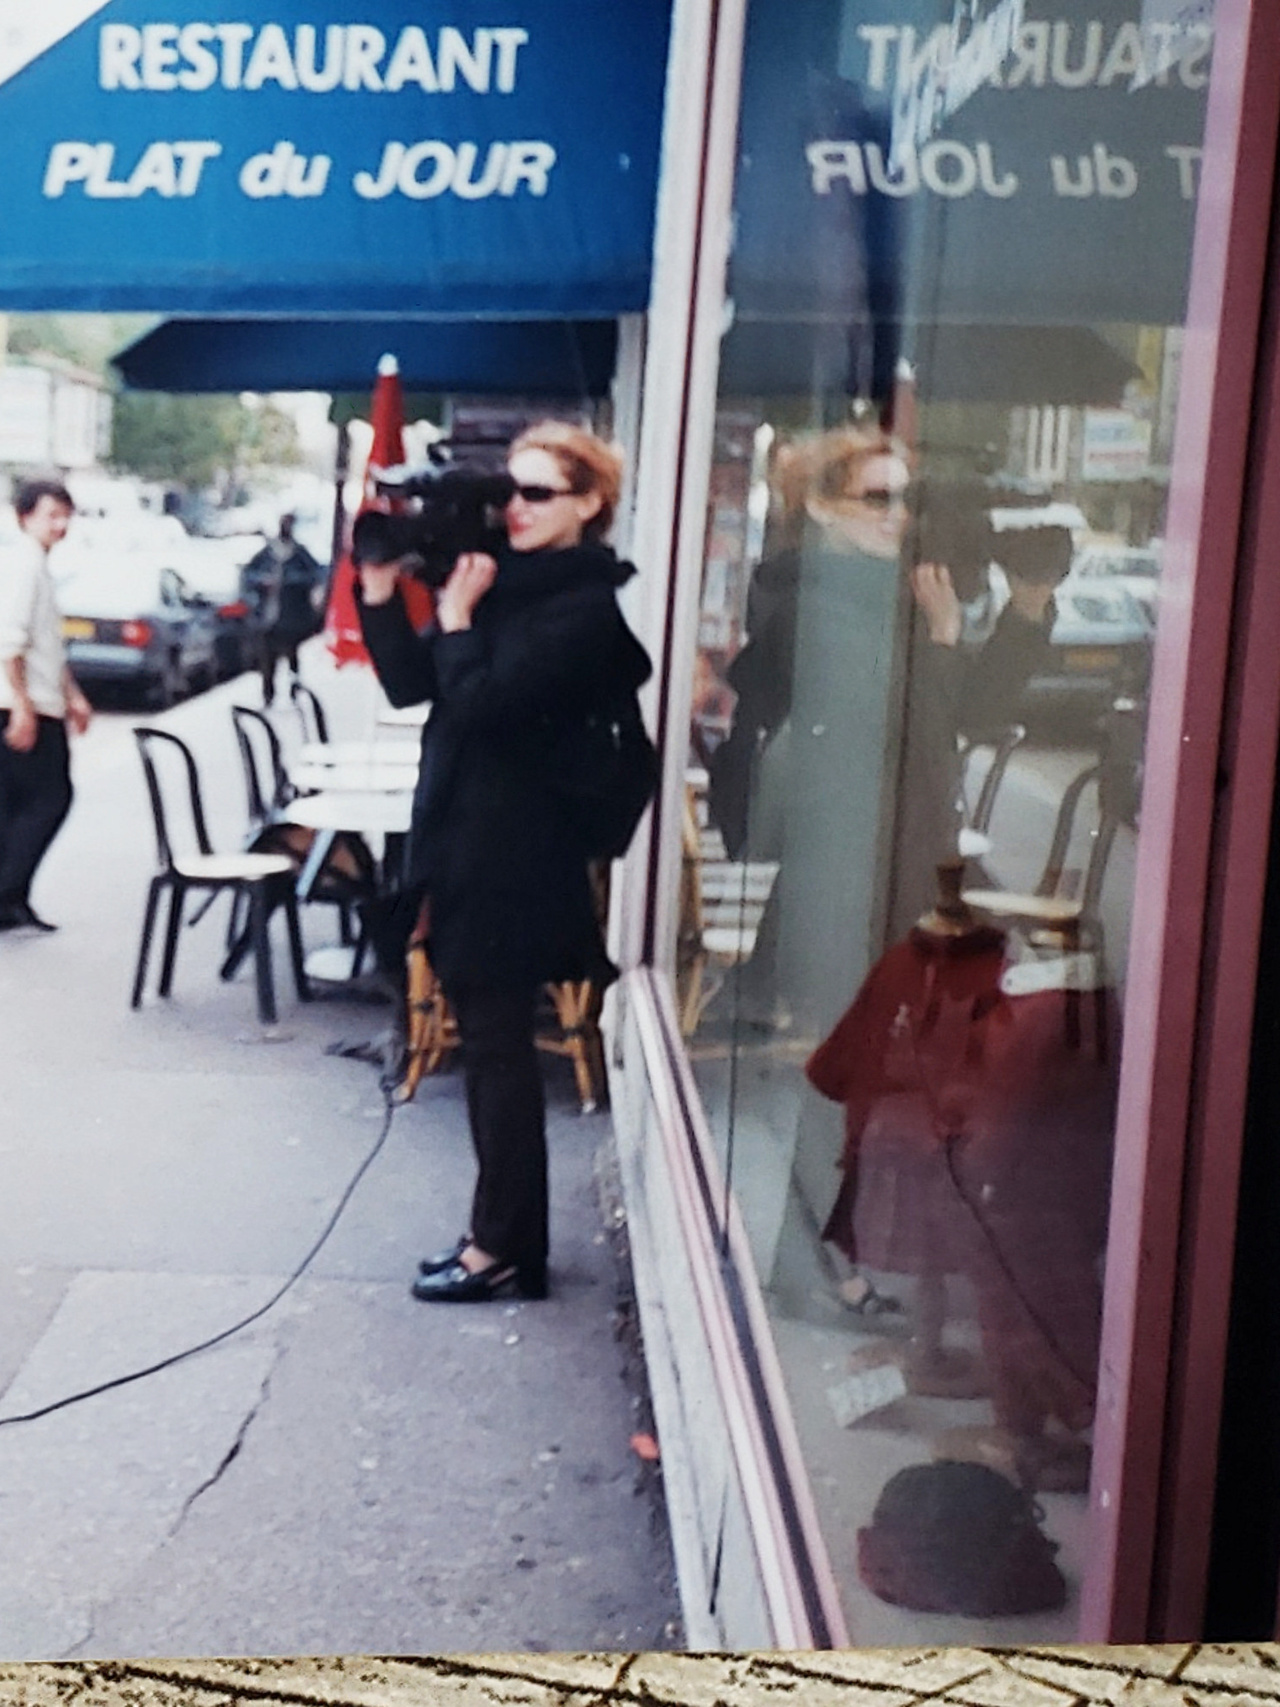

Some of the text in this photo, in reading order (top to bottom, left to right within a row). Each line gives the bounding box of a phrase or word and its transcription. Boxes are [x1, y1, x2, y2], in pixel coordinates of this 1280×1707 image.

[99, 23, 529, 93] RESTAURANT
[42, 140, 557, 200] PLAT du JOUR
